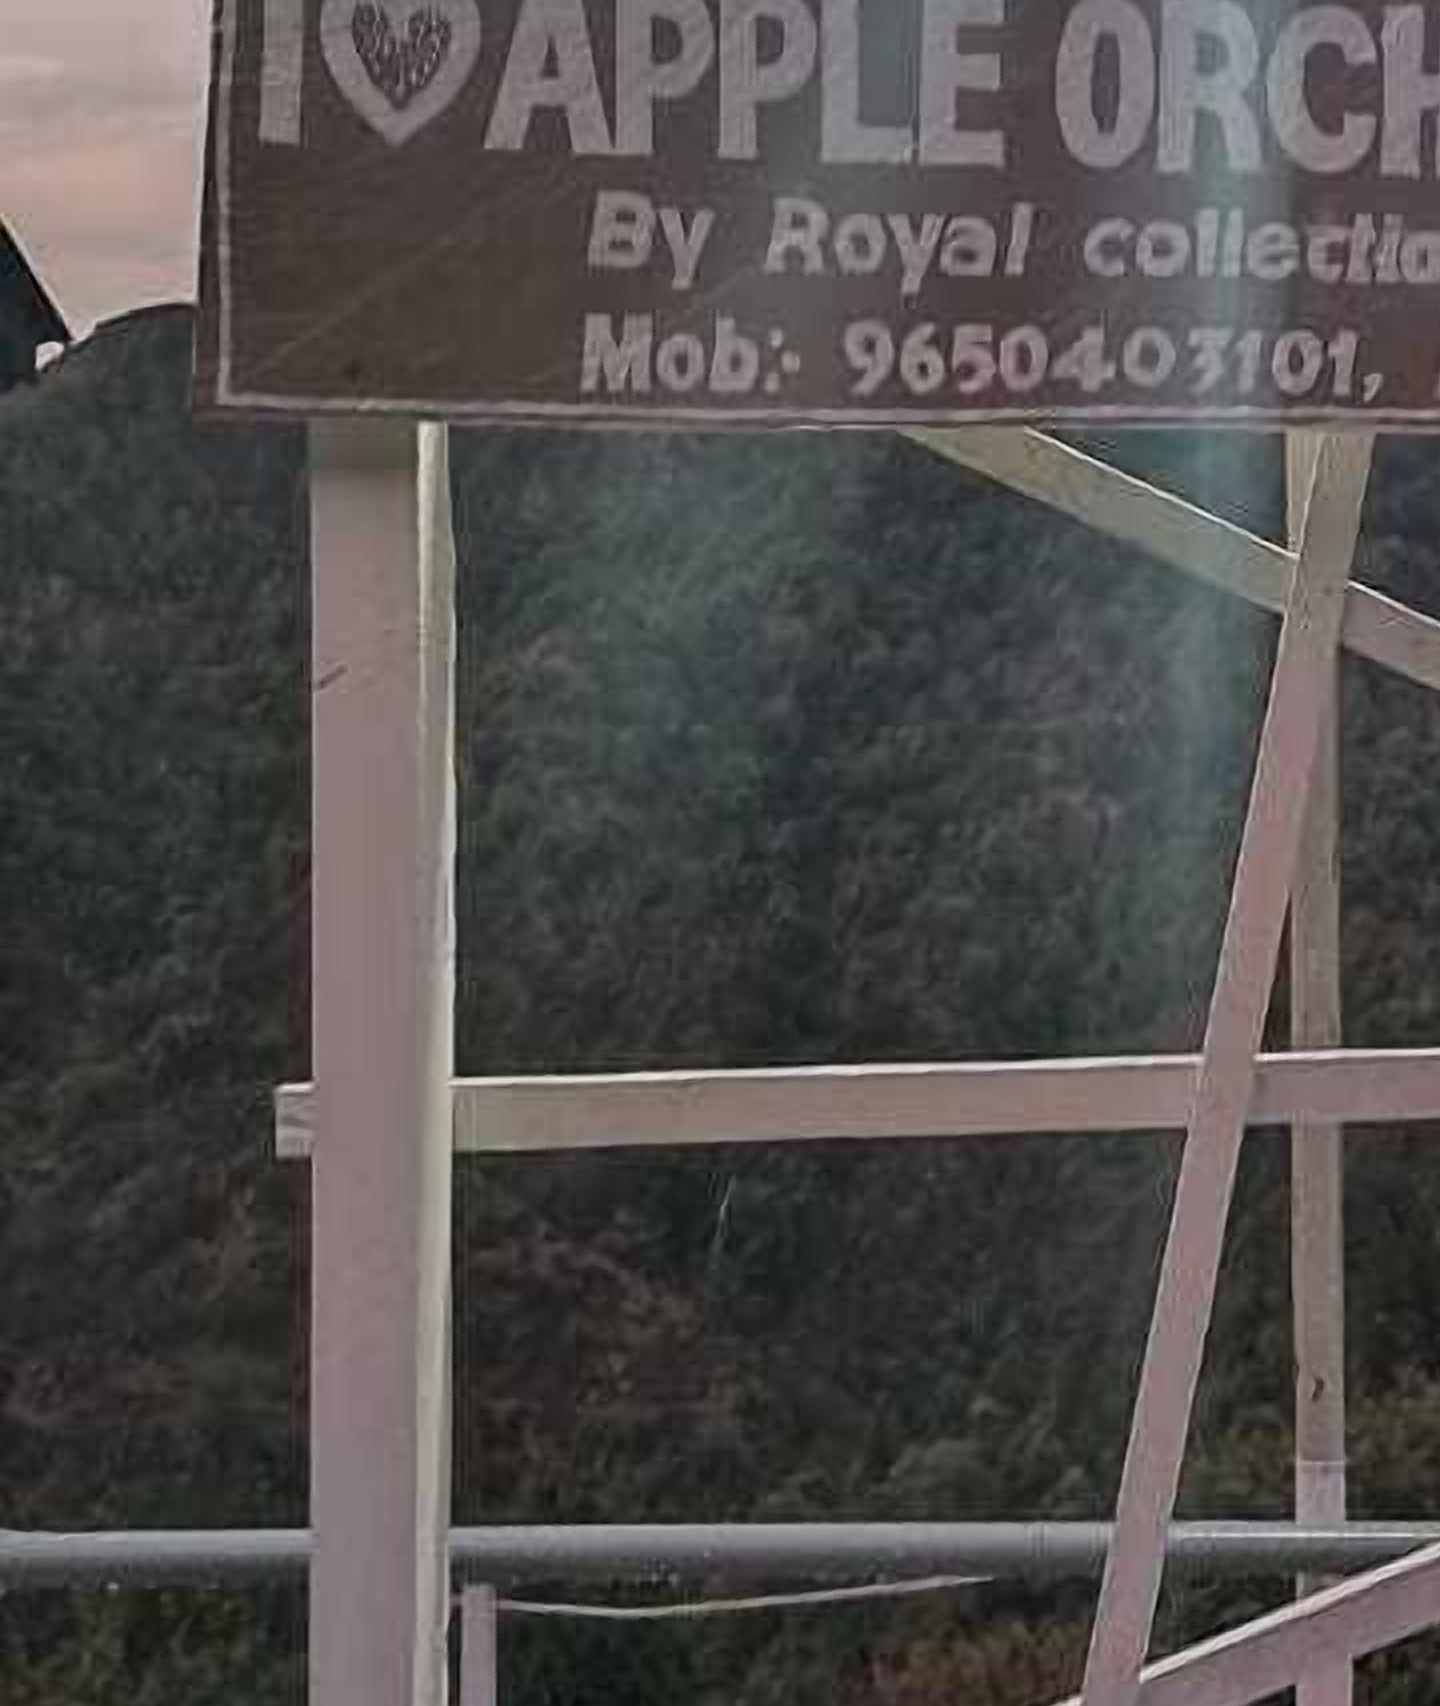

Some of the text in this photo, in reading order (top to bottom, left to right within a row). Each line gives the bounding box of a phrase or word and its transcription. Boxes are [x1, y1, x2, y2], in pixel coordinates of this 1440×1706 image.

[588, 191, 715, 290] By
[764, 196, 1032, 305] Royal
[843, 318, 1383, 402] 9650403101,
